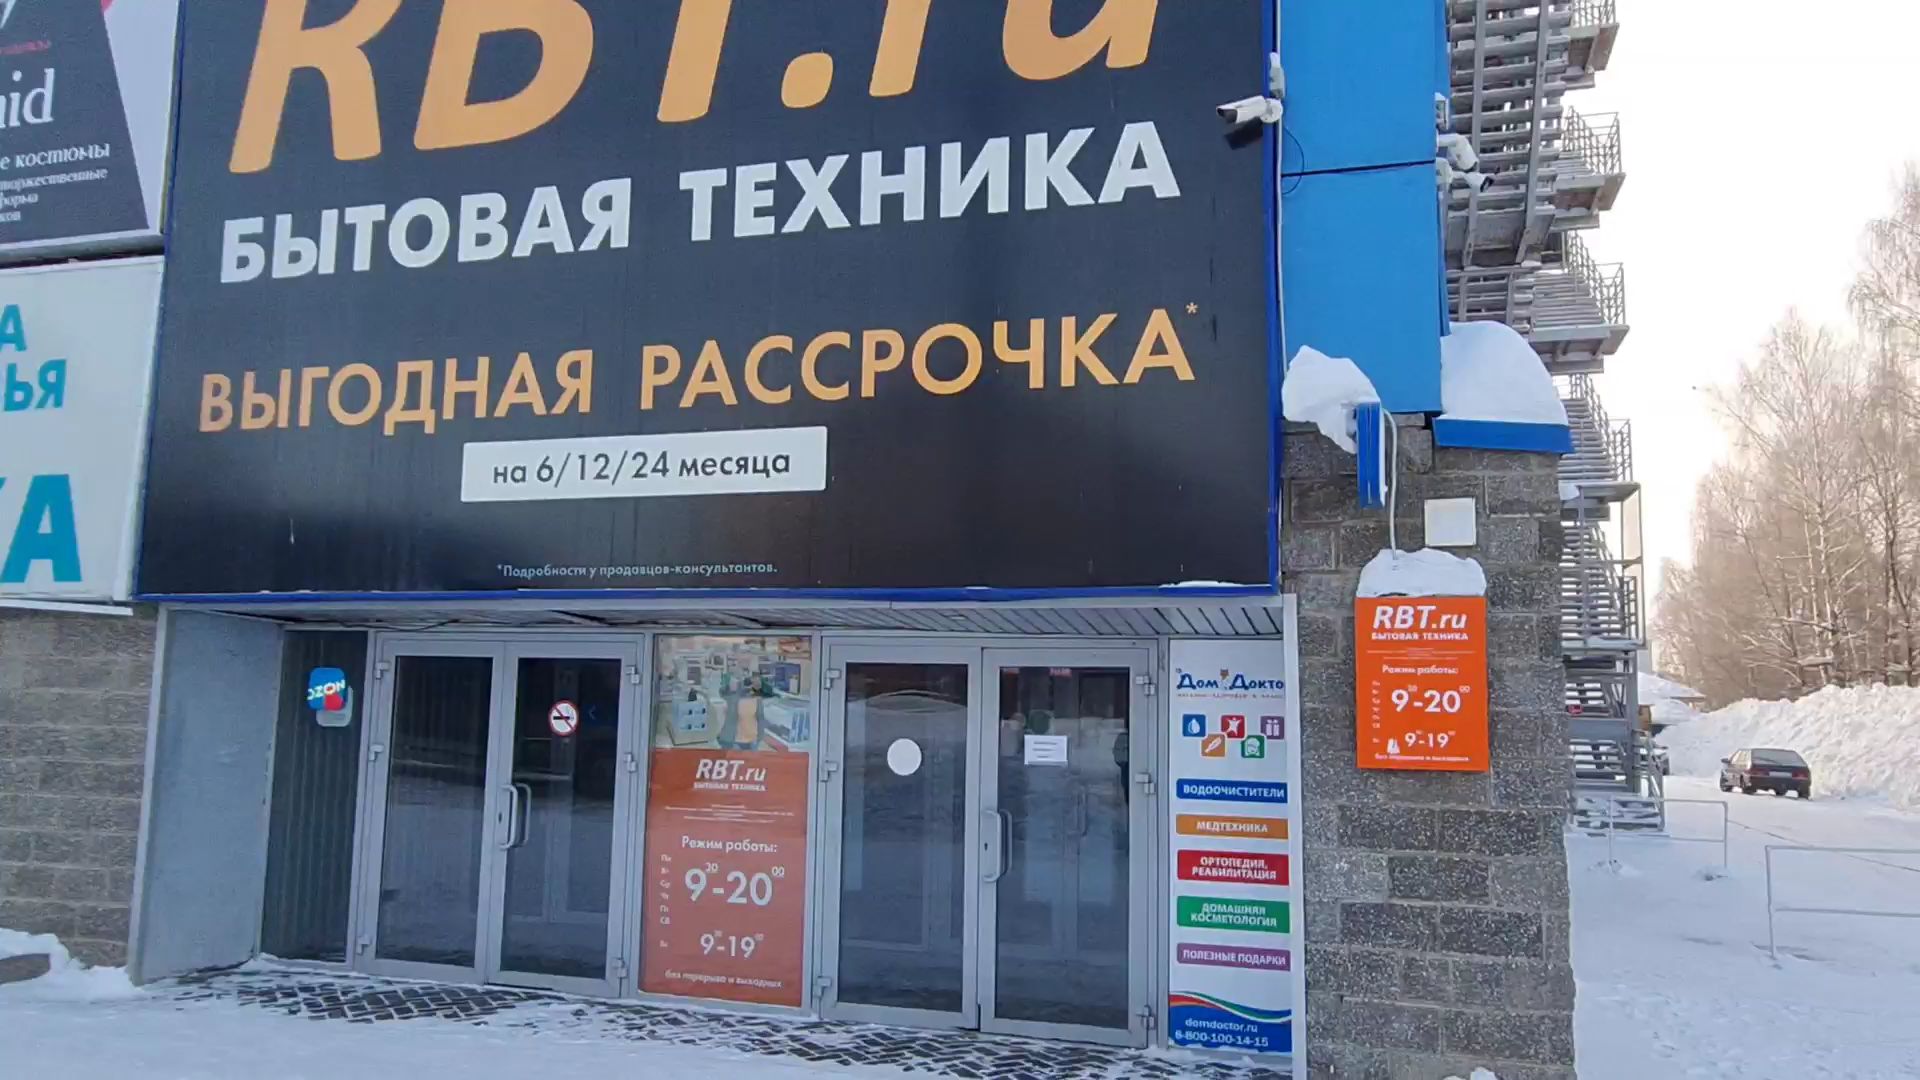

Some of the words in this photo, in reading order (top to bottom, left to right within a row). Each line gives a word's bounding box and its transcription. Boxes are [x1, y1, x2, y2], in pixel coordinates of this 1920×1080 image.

[16, 143, 110, 168] костюмы
[220, 177, 632, 283] БЫТОВАЯ
[679, 121, 1181, 241] ТЕХНИКА
[0, 304, 27, 351] А
[4, 359, 67, 411] ЬЯ
[199, 349, 593, 435] ВЫГОДНАЯ
[493, 464, 527, 484] на
[536, 449, 670, 488] 6/12/24
[678, 453, 791, 478] месяца
[0, 474, 82, 583] А
[1373, 605, 1468, 629] RBT.ru
[1371, 632, 1419, 640] БЫТОВАЯ
[1422, 632, 1469, 640] ТЕХНИКА
[695, 758, 767, 782] RBT.ru
[1183, 784, 1285, 798] ВОДООЧИСТИТЕЛИ
[1196, 821, 1269, 833] МЕДТЕХНИКА
[682, 835, 723, 849] Режим
[725, 839, 778, 853] работы:
[1200, 856, 1268, 869] ОРТОПЕДИЯ,
[1192, 866, 1277, 880] РЕАБИЛИТАЦИЯ
[1201, 903, 1266, 915] ДОМАШНЯЯ
[1190, 913, 1277, 927] КОСМЕТОЛОГИЯ
[1183, 949, 1236, 962] ПОЛЕЗНЫЕ
[1237, 953, 1286, 965] ПОДАРКИ
[1185, 1017, 1258, 1032] domdoctor.ru
